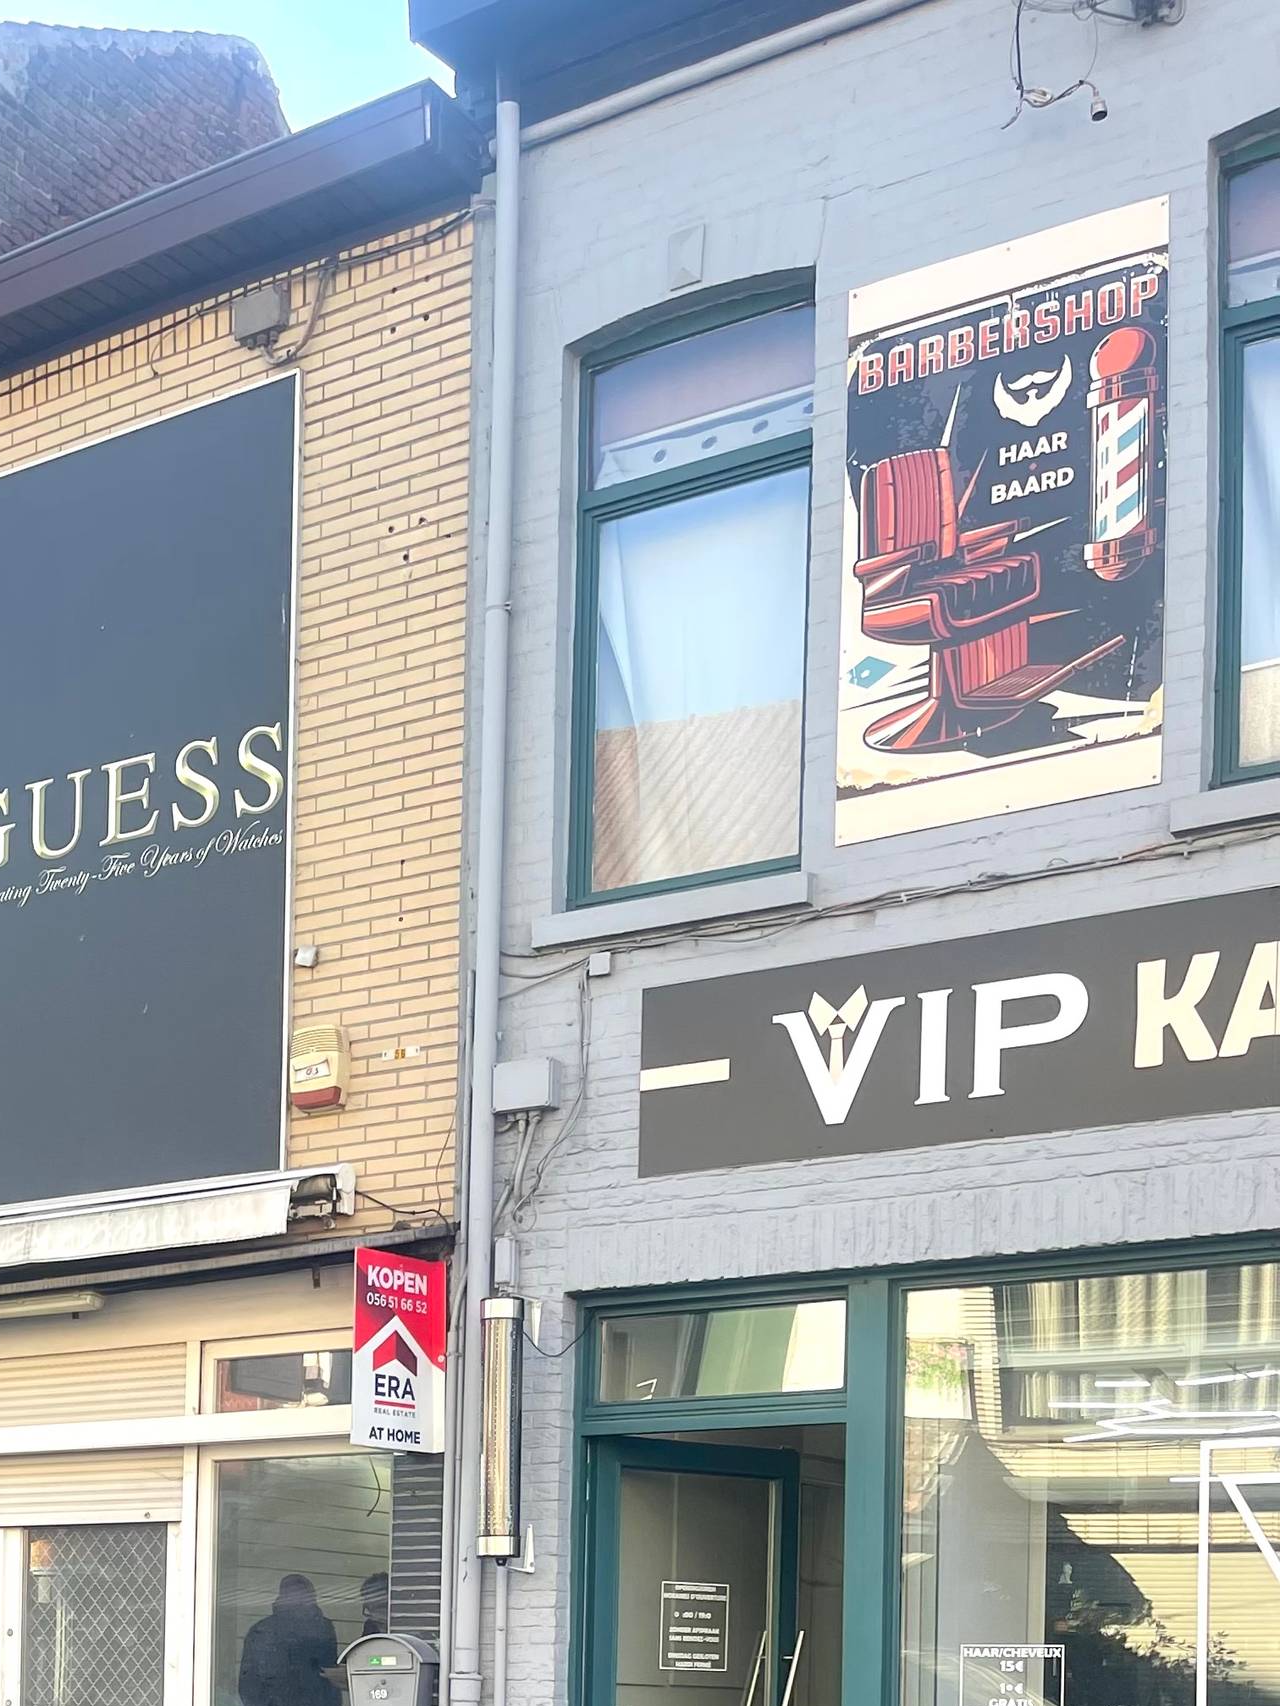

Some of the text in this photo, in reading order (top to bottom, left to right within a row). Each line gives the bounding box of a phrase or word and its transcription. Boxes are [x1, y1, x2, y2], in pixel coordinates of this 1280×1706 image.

[858, 275, 1159, 394] BARBERSHOP
[999, 431, 1068, 466] HAAR
[990, 467, 1075, 505] BAARD
[35, 852, 136, 895] Twenty-Five
[140, 843, 194, 878] Years
[194, 837, 216, 868] of
[215, 820, 284, 856] Watches
[772, 973, 1089, 1125] VIP
[367, 1264, 428, 1296] KOPEN
[366, 1292, 428, 1315] 056 51 66 52
[374, 1373, 416, 1401] ERA
[374, 1407, 417, 1419] REAL ESTATE
[369, 1425, 421, 1445] AT HOME
[963, 1647, 1062, 1658] HAAR/CHEVEUX
[1000, 1660, 1024, 1672] 15€
[370, 1689, 388, 1699] 169
